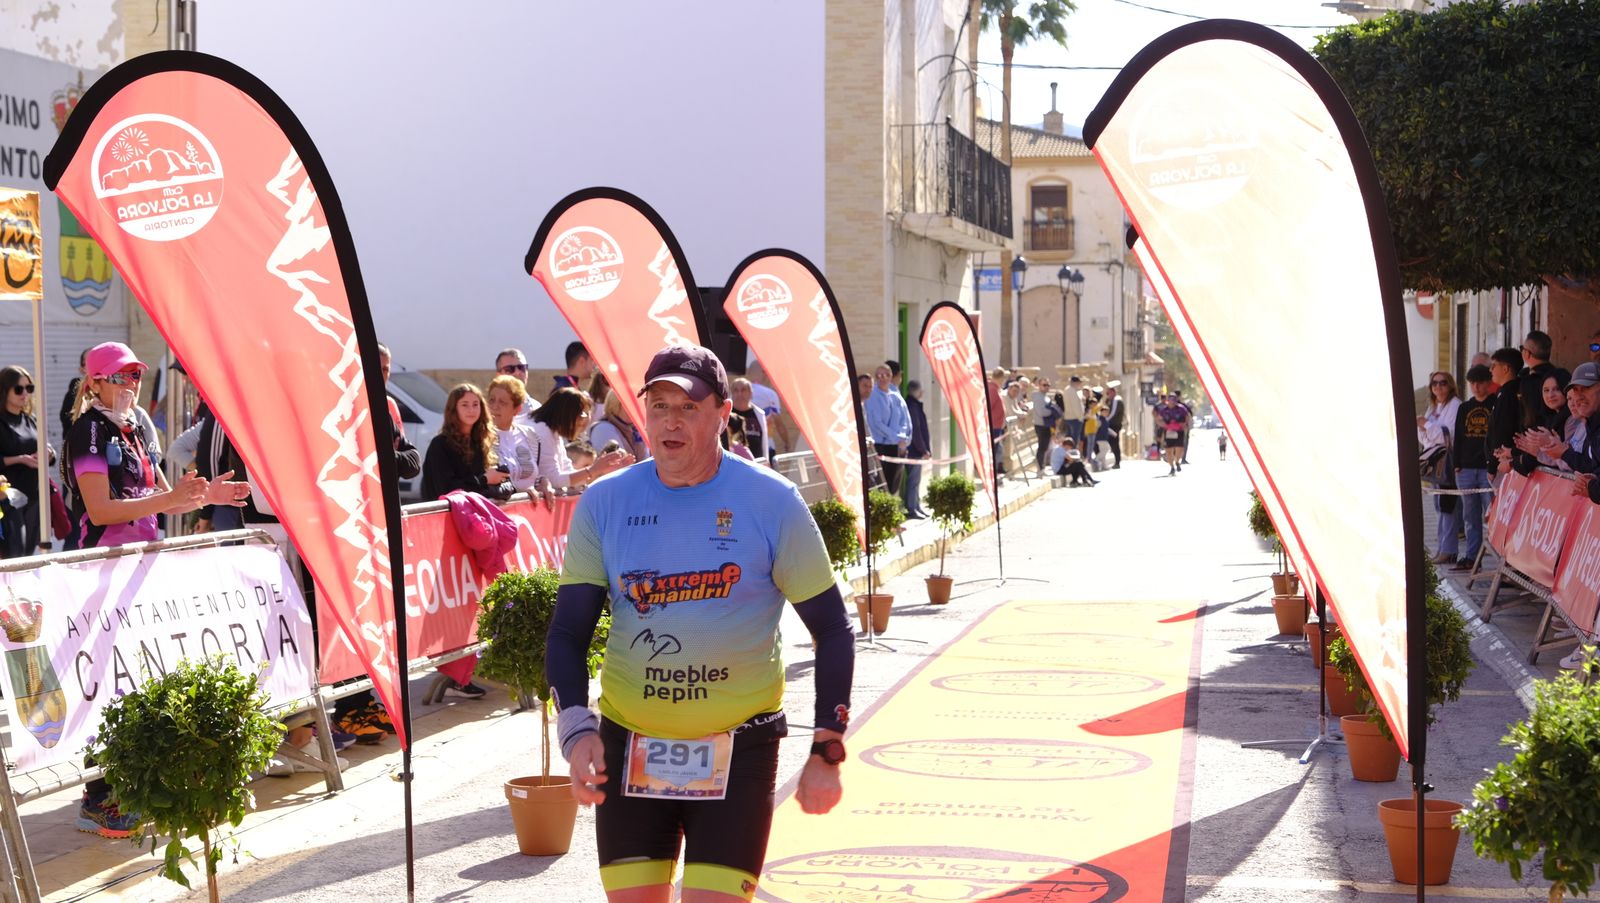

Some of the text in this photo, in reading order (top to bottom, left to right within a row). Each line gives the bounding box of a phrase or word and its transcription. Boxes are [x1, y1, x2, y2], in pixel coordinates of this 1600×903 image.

[0, 93, 40, 130] IMO
[627, 515, 658, 526] GOBIK
[404, 554, 481, 618] EOLIA
[646, 581, 733, 605] mandril
[65, 582, 284, 639] AYUNTAMIENTO DE
[74, 613, 299, 702] CANTORIA
[645, 664, 729, 684] muebles
[647, 742, 709, 768] 291
[806, 859, 1080, 875] LA POLVORA
